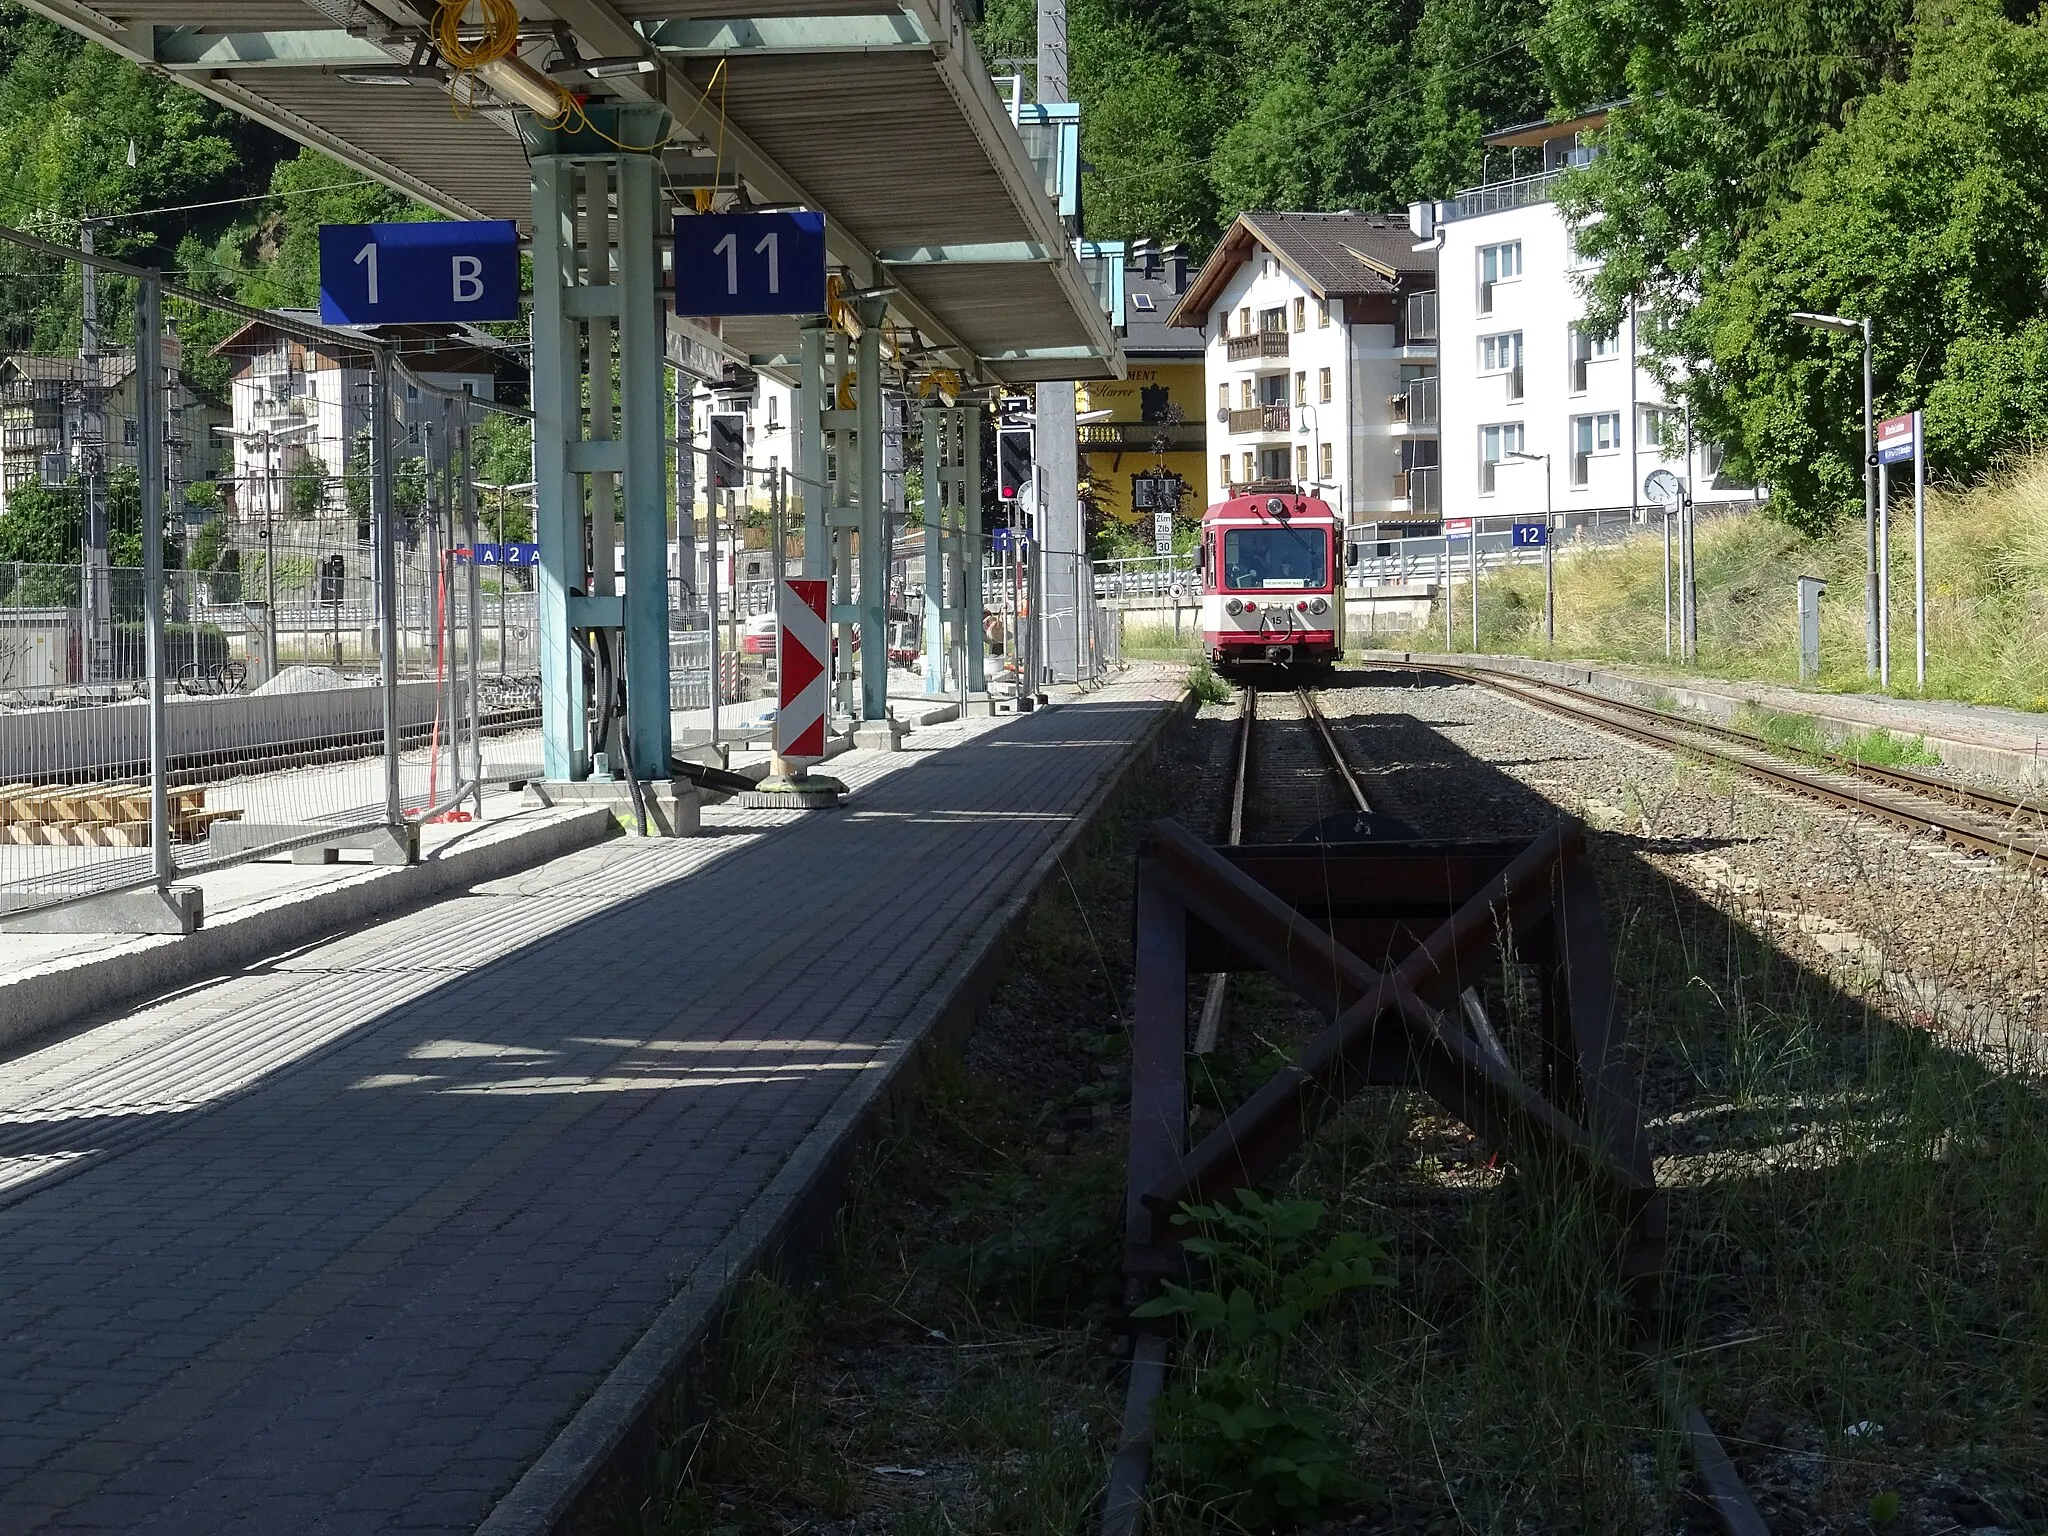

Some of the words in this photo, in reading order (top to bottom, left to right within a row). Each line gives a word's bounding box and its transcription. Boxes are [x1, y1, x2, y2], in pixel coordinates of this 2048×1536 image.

[713, 232, 778, 294] 11
[353, 243, 378, 304] 1
[452, 255, 484, 302] B
[1519, 527, 1540, 543] 12
[509, 547, 520, 562] 2
[530, 550, 540, 562] A
[1158, 542, 1170, 552] 30
[483, 550, 494, 562] A
[1271, 616, 1282, 625] 15
